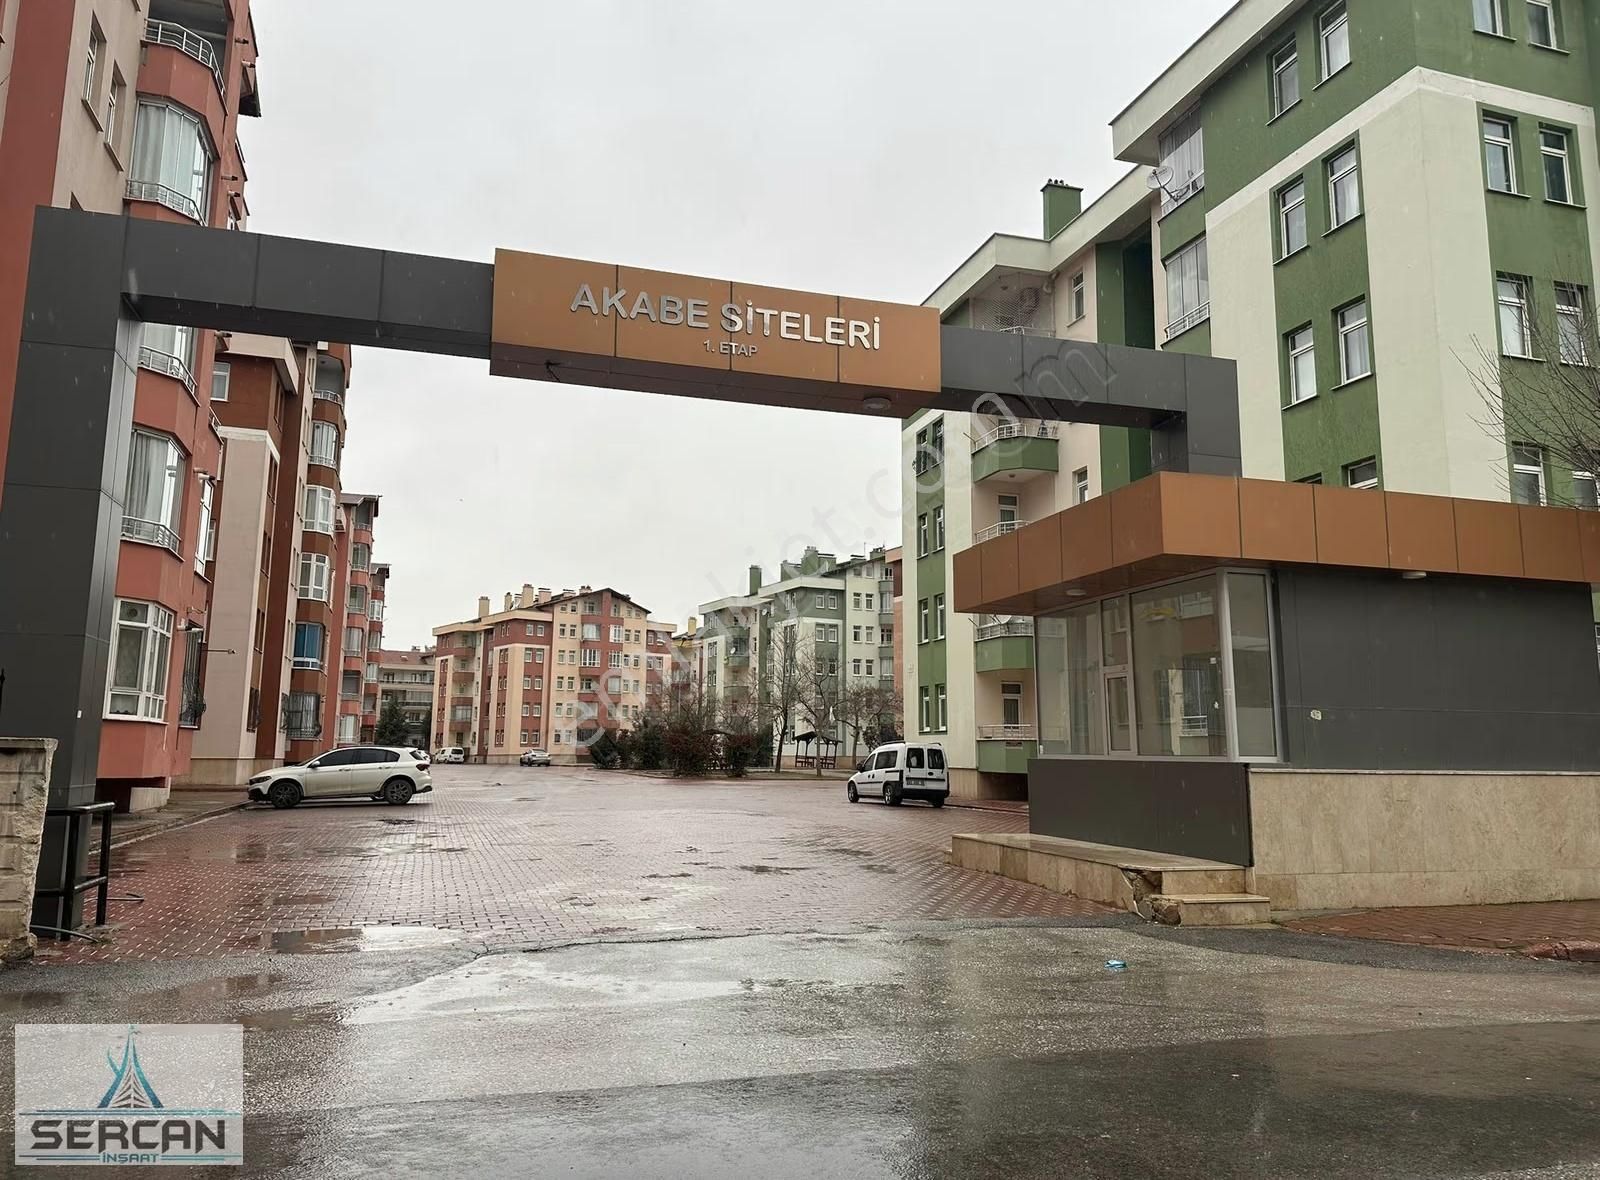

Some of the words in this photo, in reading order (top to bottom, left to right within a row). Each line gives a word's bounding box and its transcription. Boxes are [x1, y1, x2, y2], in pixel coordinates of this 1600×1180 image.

[570, 283, 710, 329] AKABE
[719, 299, 881, 350] SİTELERİ
[703, 339, 716, 353] 1.
[719, 341, 758, 357] ETAP
